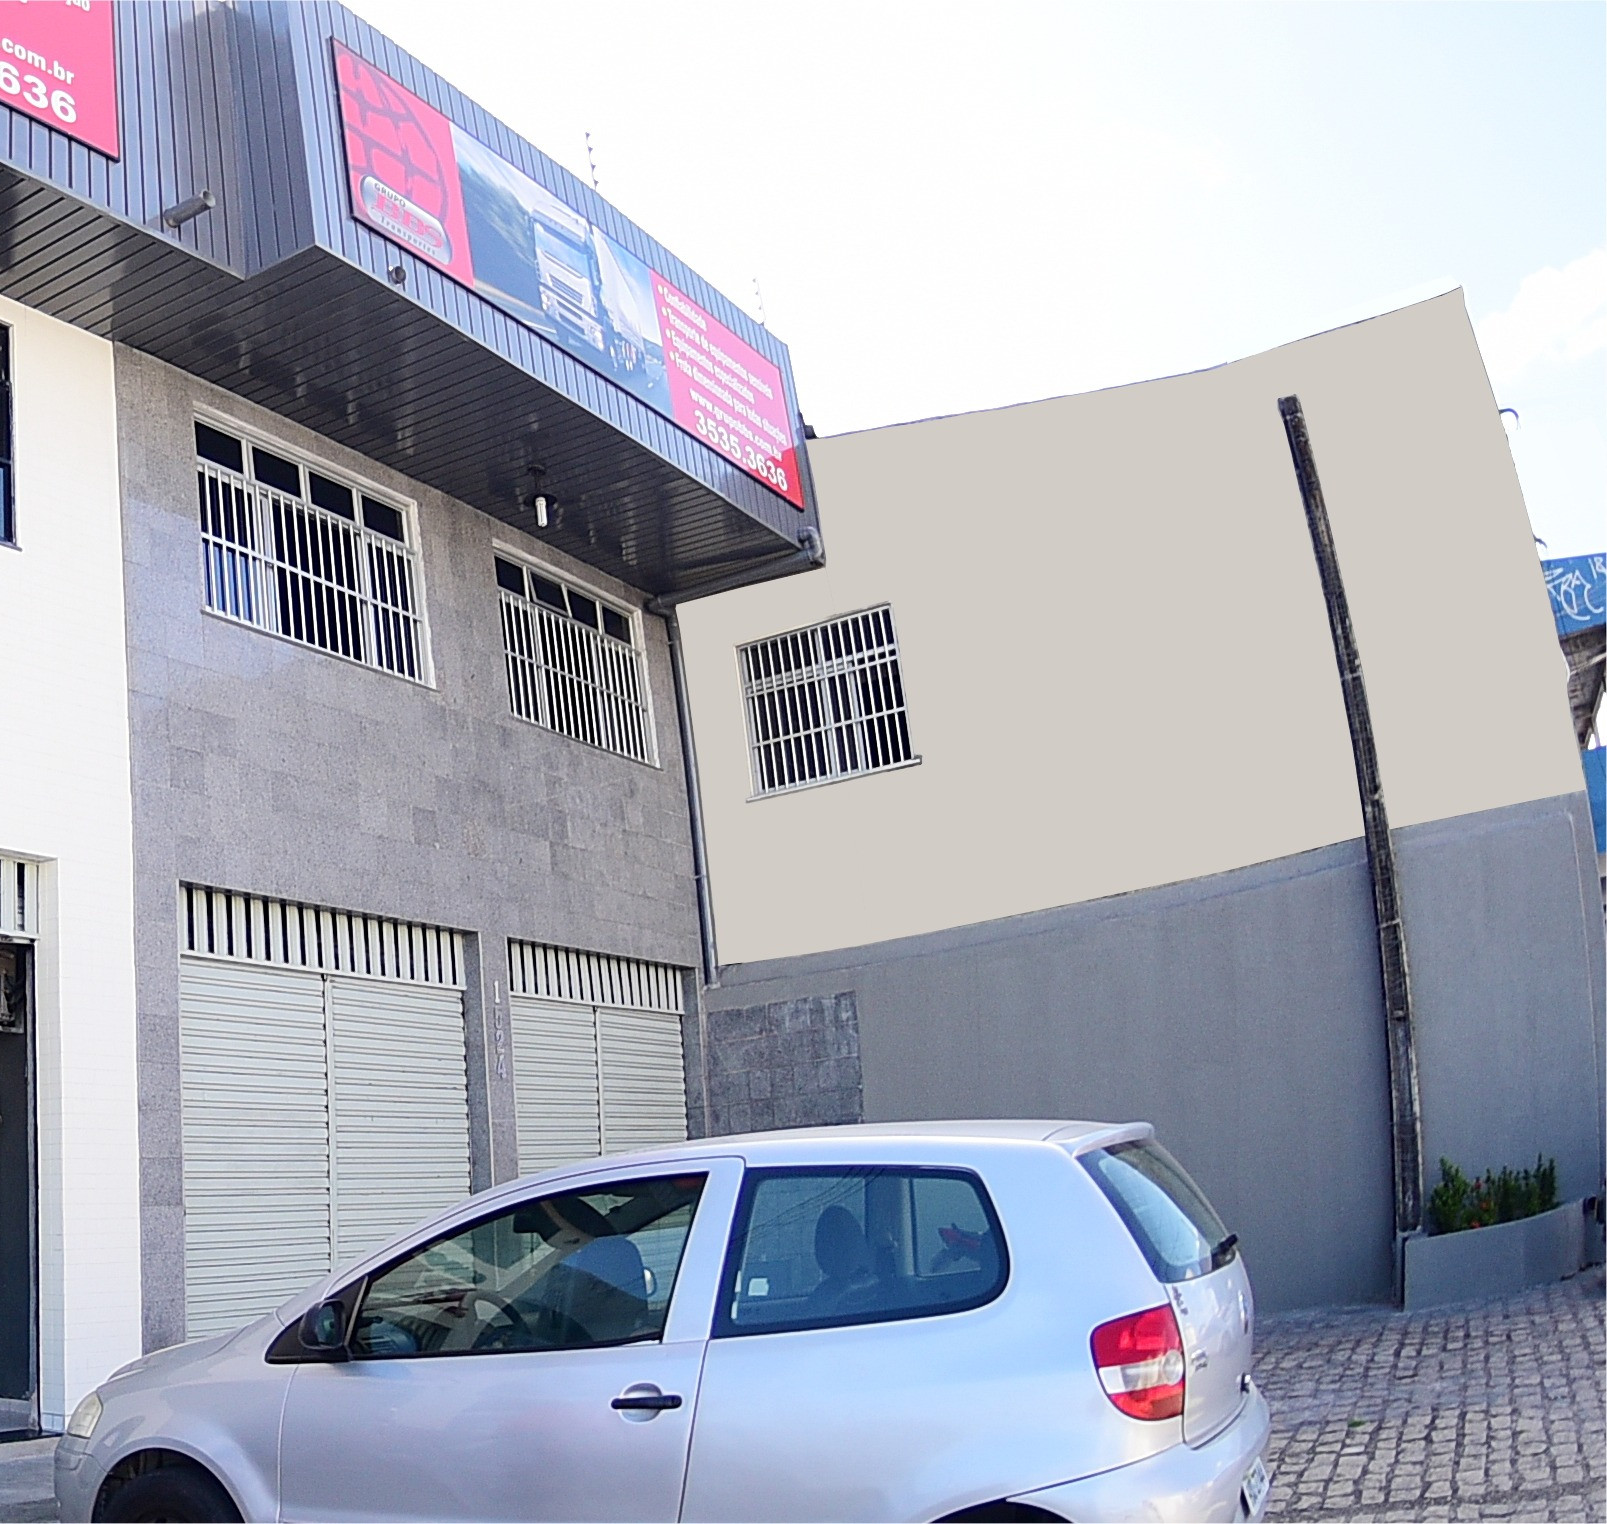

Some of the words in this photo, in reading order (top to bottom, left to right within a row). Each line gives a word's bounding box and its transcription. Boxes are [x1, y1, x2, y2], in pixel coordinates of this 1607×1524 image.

[374, 182, 406, 208] GRUPO
[694, 409, 788, 492] 3535.3636
[493, 980, 507, 1079] 1524
